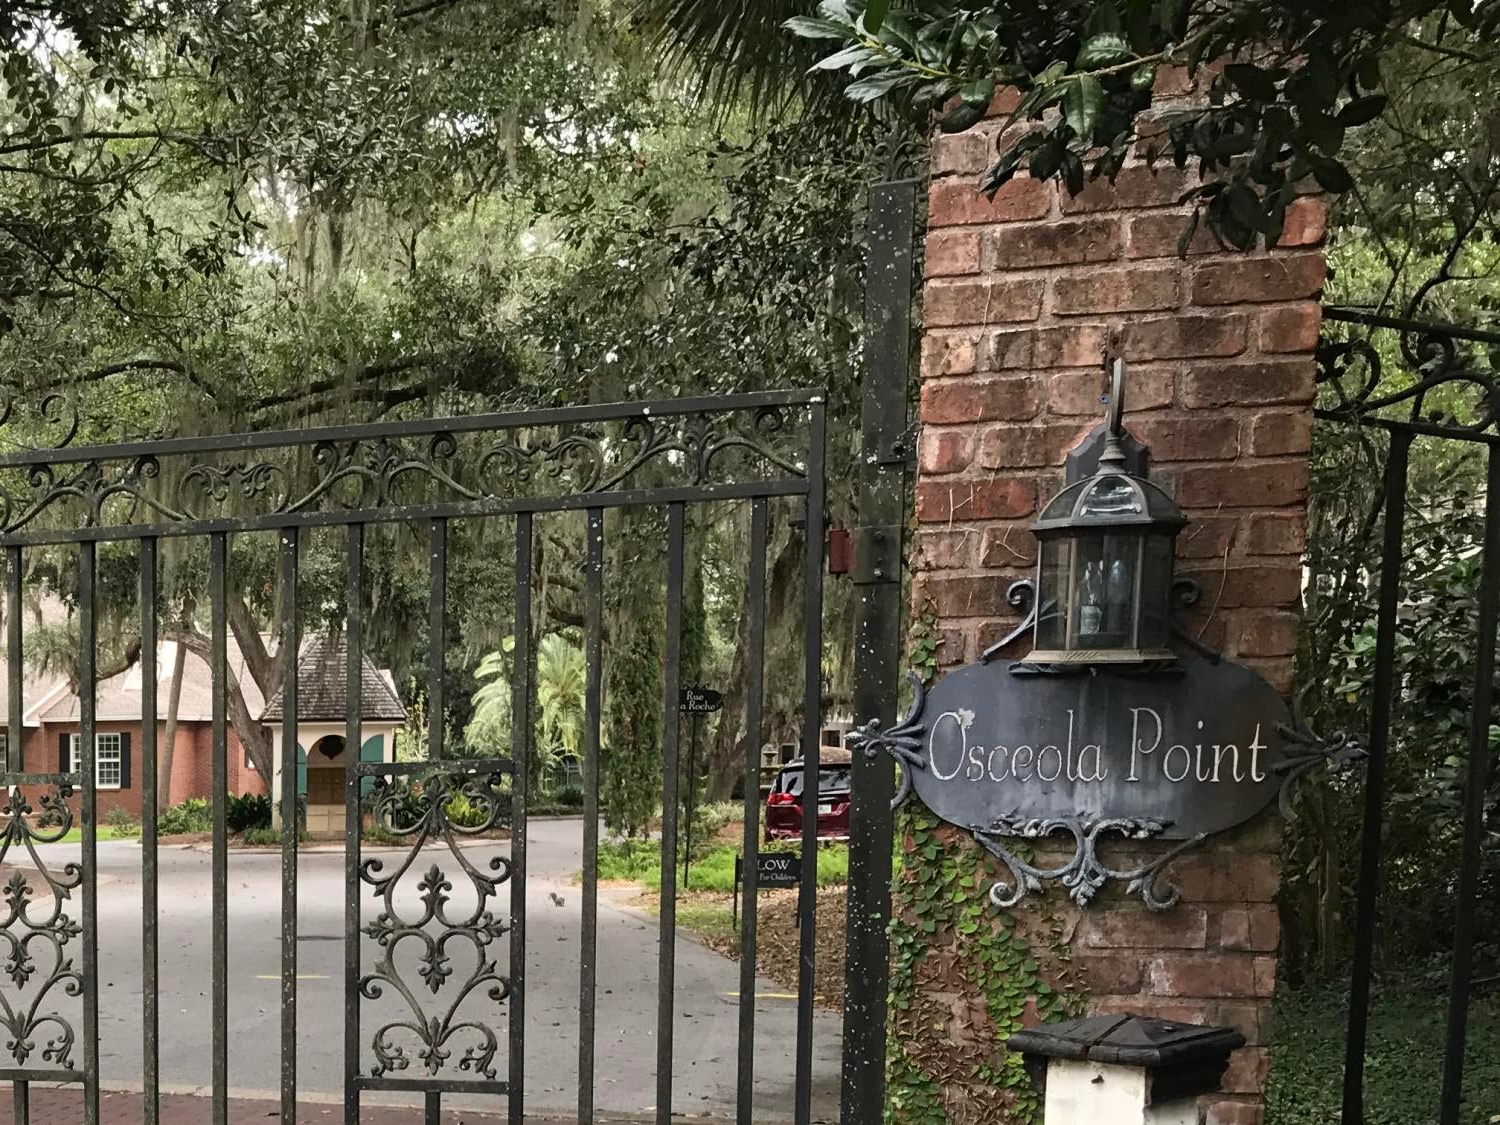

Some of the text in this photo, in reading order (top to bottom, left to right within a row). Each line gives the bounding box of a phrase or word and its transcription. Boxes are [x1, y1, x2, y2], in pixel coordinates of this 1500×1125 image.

[687, 690, 704, 700] Rue
[689, 700, 716, 710] Roche
[929, 707, 1267, 782] Osceola Point
[757, 859, 791, 870] LOW
